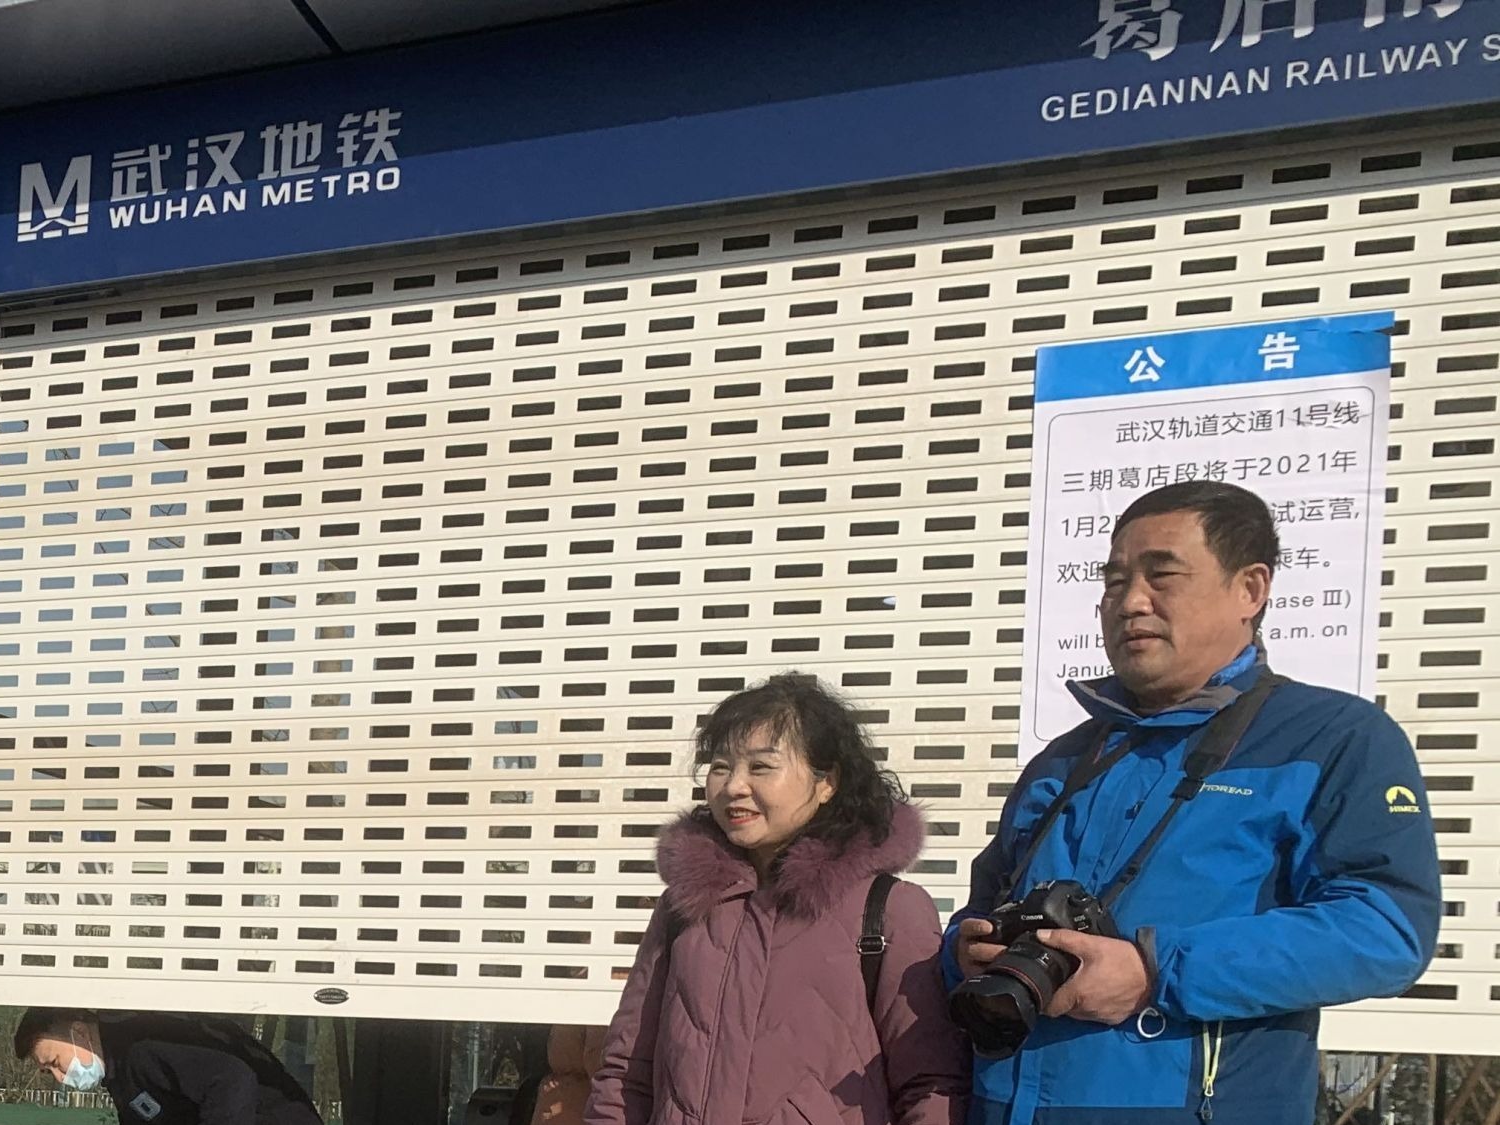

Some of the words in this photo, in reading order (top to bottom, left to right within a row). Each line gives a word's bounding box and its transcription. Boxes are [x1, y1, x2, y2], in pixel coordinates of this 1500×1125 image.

[1041, 66, 1271, 123] GEDIANNAN
[1285, 38, 1468, 88] RAILWAY
[109, 106, 402, 203] 武汉地铁
[109, 188, 248, 230] WUHAN
[260, 167, 401, 208] METRO
[1124, 331, 1300, 384] 公告
[1115, 401, 1361, 444] 武汉轨道交通11号线
[1060, 450, 1358, 494] 三期葛店段将于2021年
[1057, 634, 1089, 650] will
[1322, 624, 1348, 638] on
[1020, 913, 1044, 921] Canon
